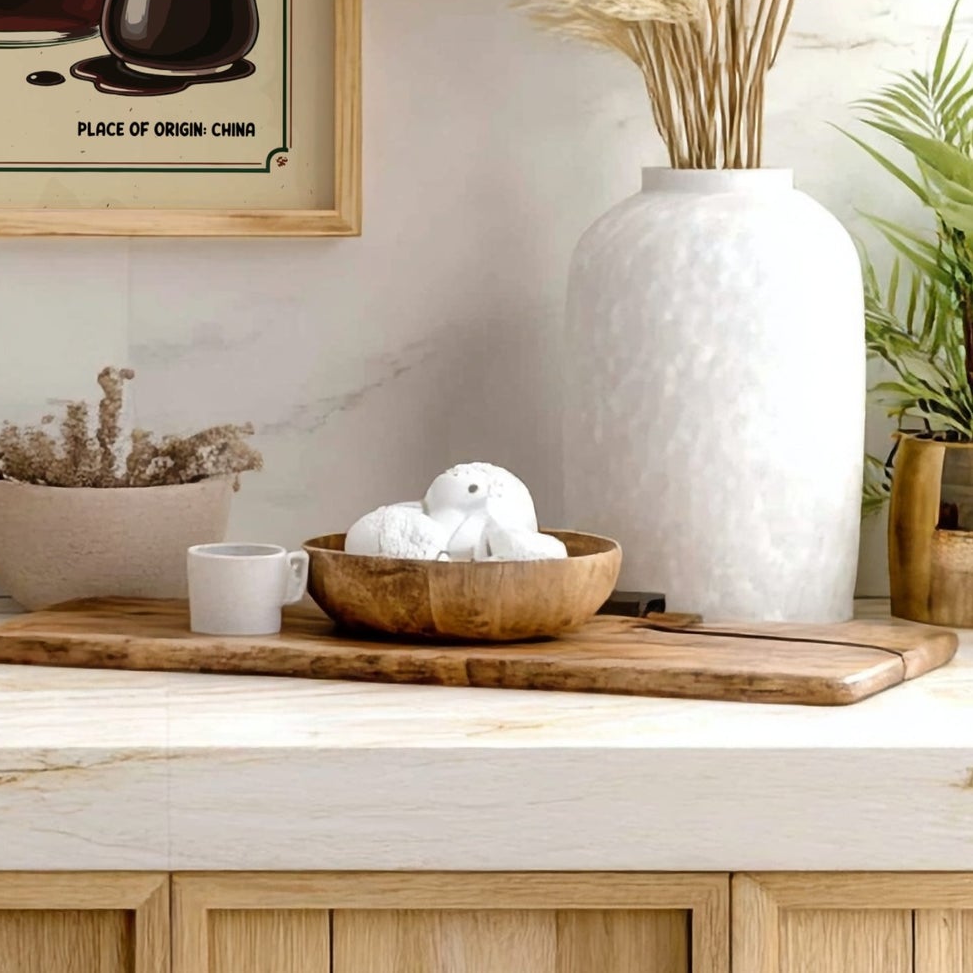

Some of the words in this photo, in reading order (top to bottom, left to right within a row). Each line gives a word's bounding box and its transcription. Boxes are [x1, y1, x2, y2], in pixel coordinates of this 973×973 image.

[77, 121, 125, 137] PLACE
[129, 121, 150, 137] OF
[153, 121, 207, 137] ORIGIN:
[211, 121, 256, 137] CHINA
